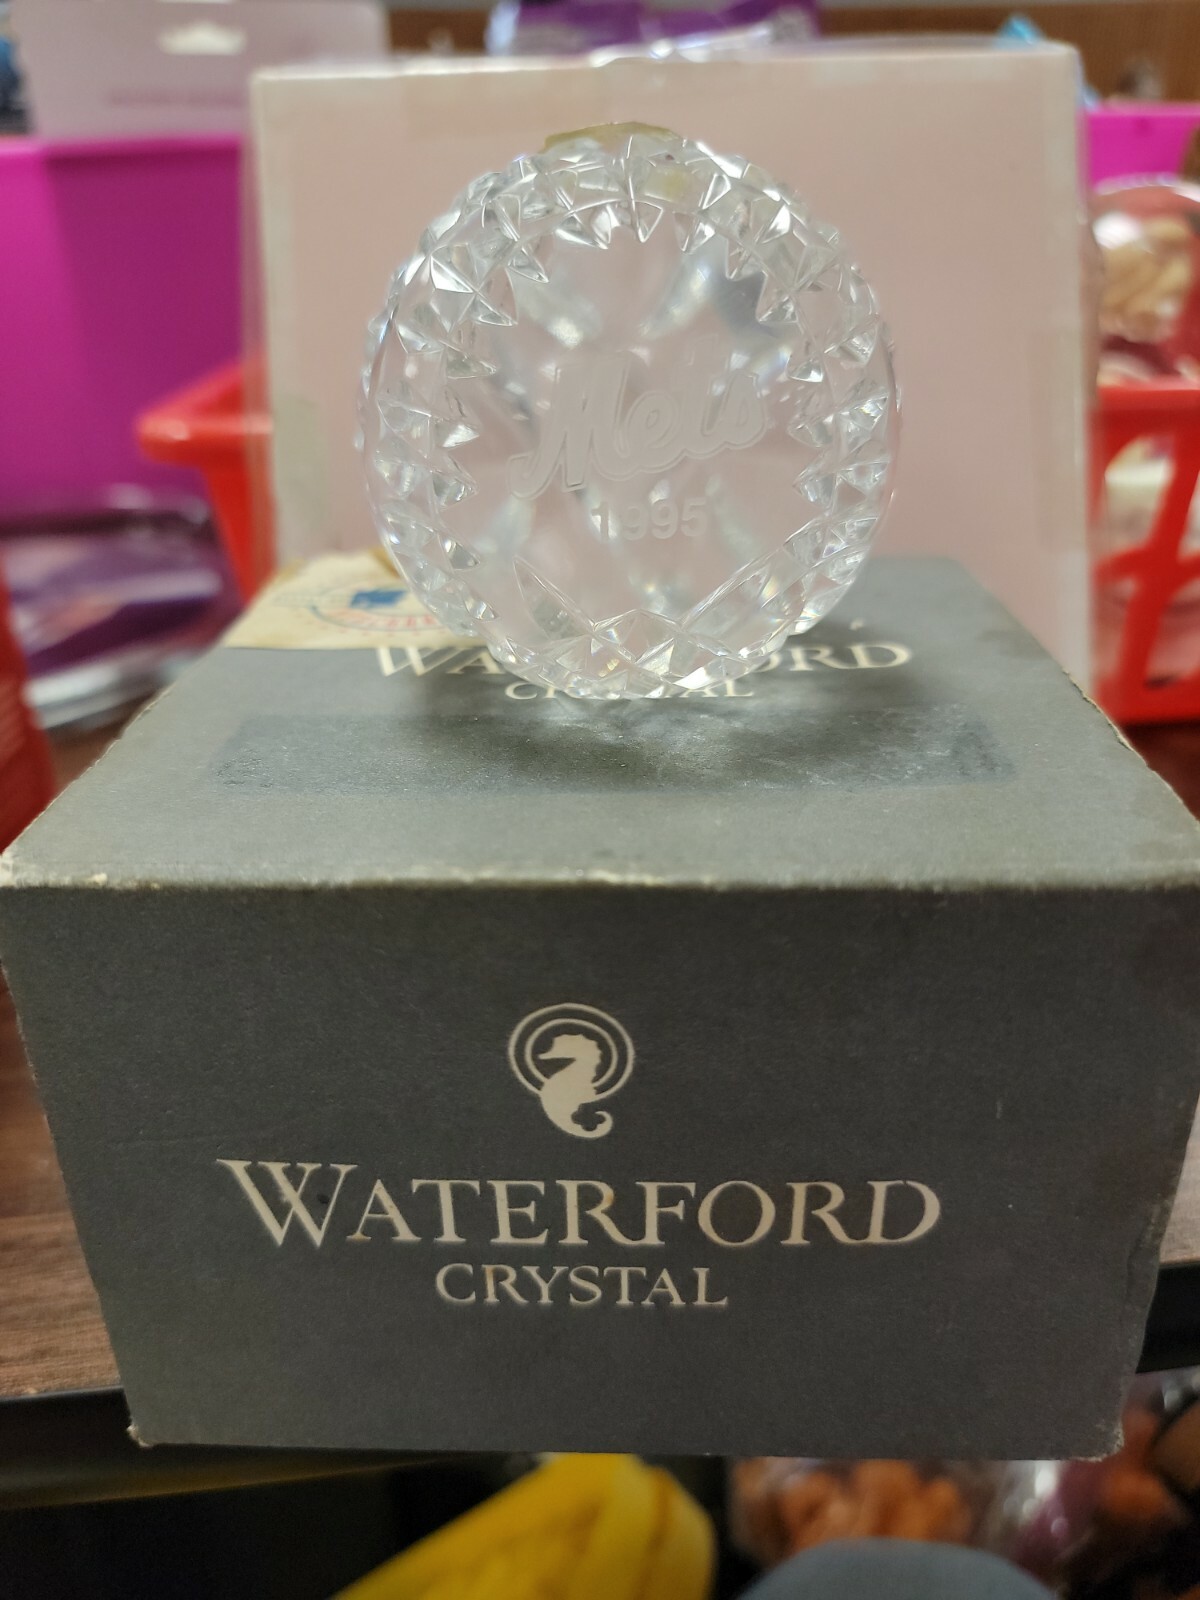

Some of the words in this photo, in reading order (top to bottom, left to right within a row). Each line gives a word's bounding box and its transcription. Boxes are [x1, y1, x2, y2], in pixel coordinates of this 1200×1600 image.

[505, 335, 767, 500] Mets
[591, 497, 708, 541] 1995
[217, 1159, 941, 1248] WATERFORD
[435, 1264, 729, 1308] CRYSTAL
